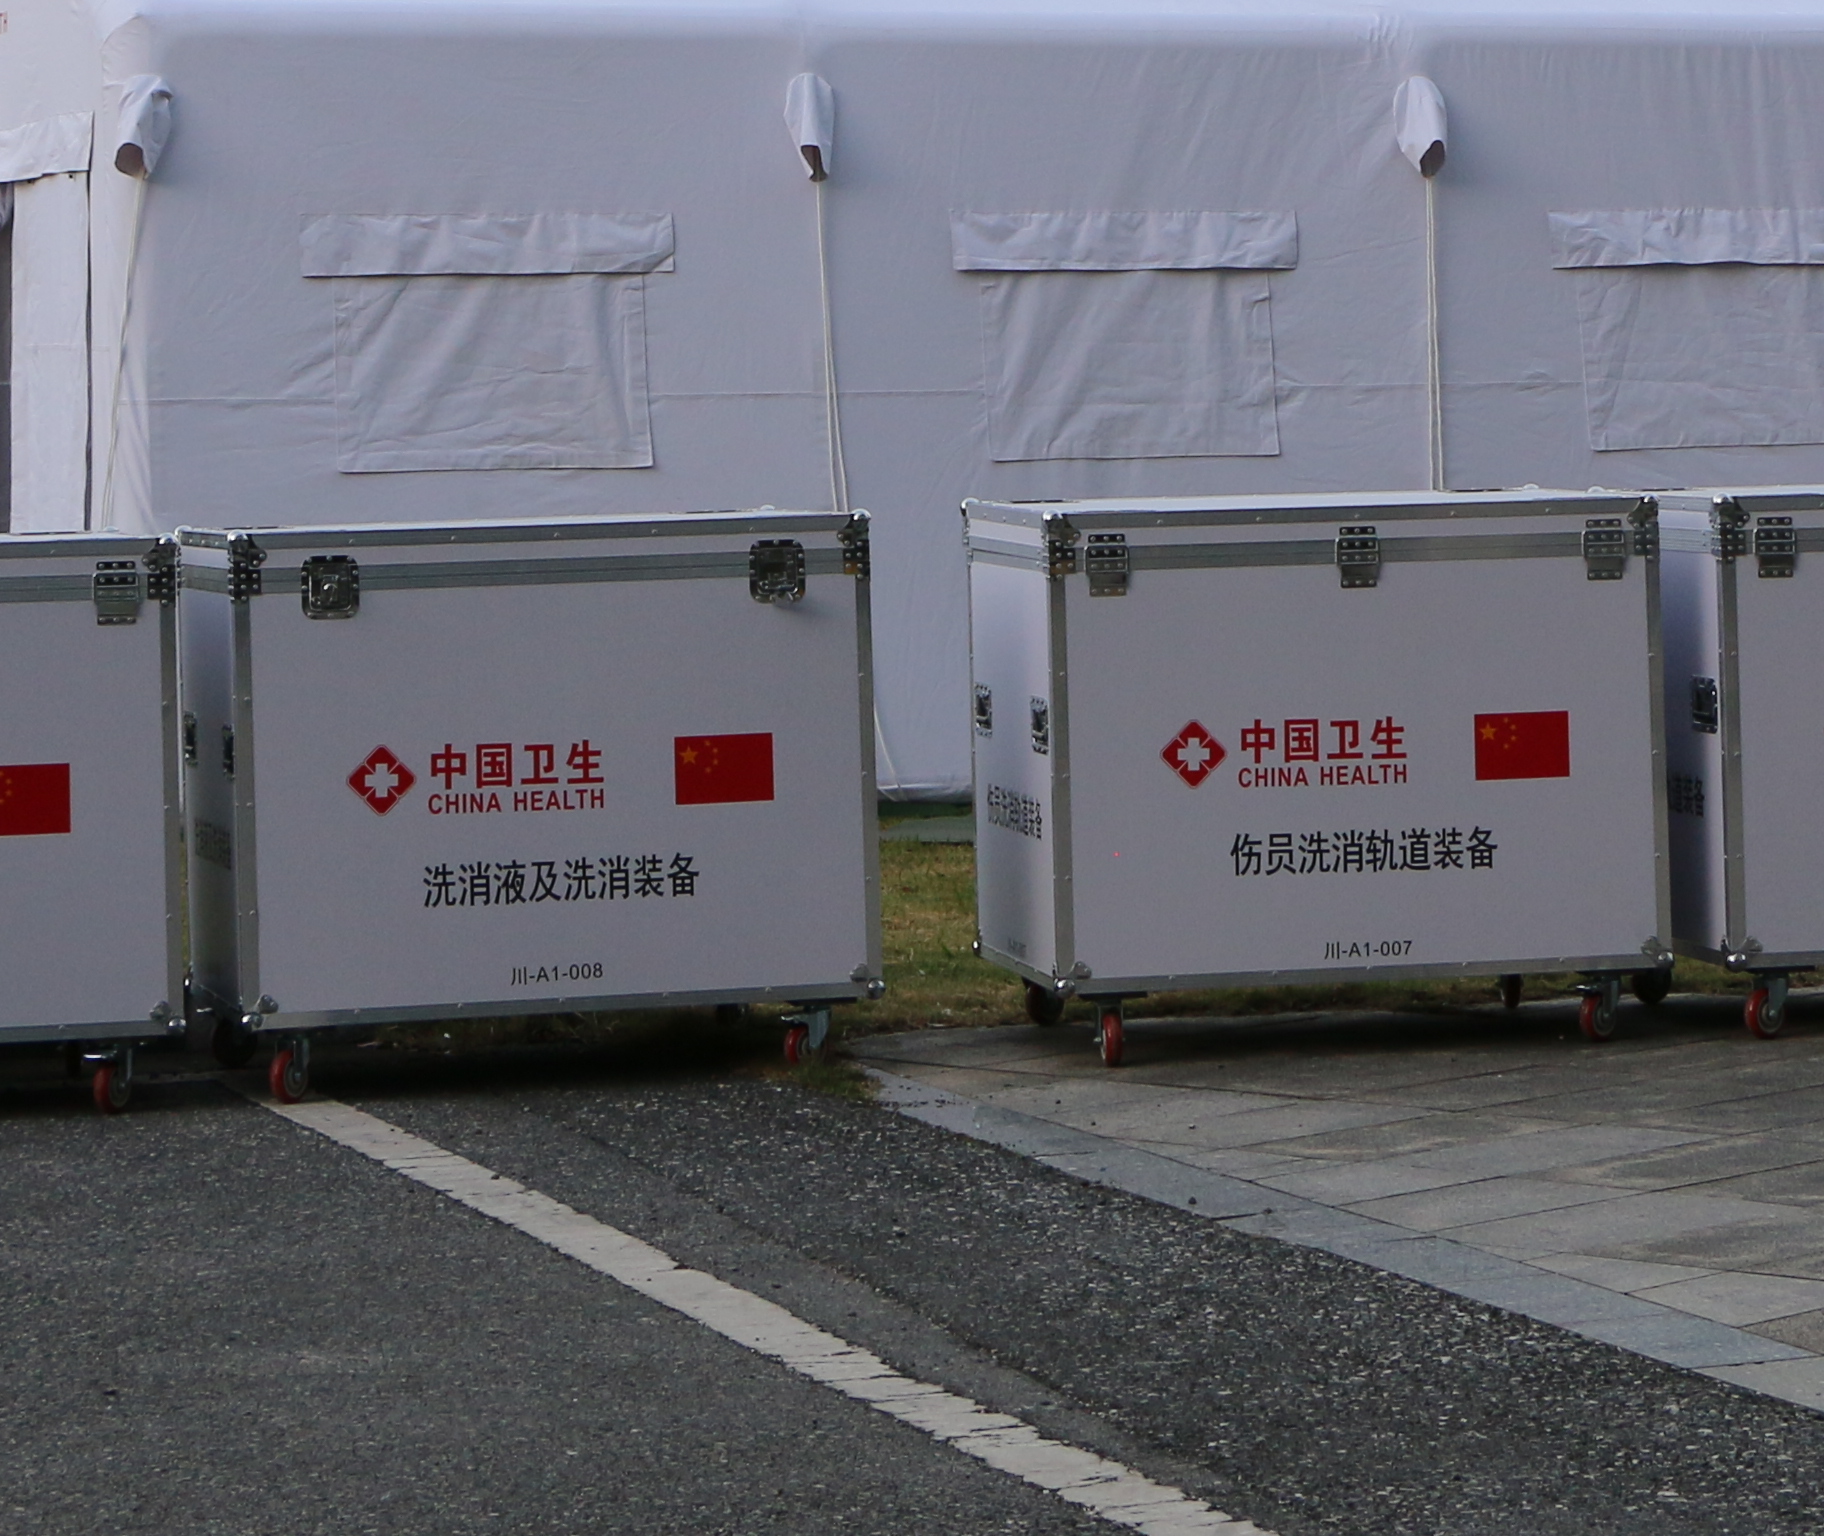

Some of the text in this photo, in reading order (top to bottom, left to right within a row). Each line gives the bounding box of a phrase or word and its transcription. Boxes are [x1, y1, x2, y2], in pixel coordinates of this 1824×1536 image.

[1241, 717, 1407, 763] 中国卫生
[431, 741, 604, 789] 中国卫生
[1238, 764, 1408, 788] CHINA HEALTH
[429, 790, 604, 815] CHINA HEALTH
[1231, 826, 1497, 876] 伤员洗消轨道装备
[424, 853, 699, 907] 洗消液及洗消装备
